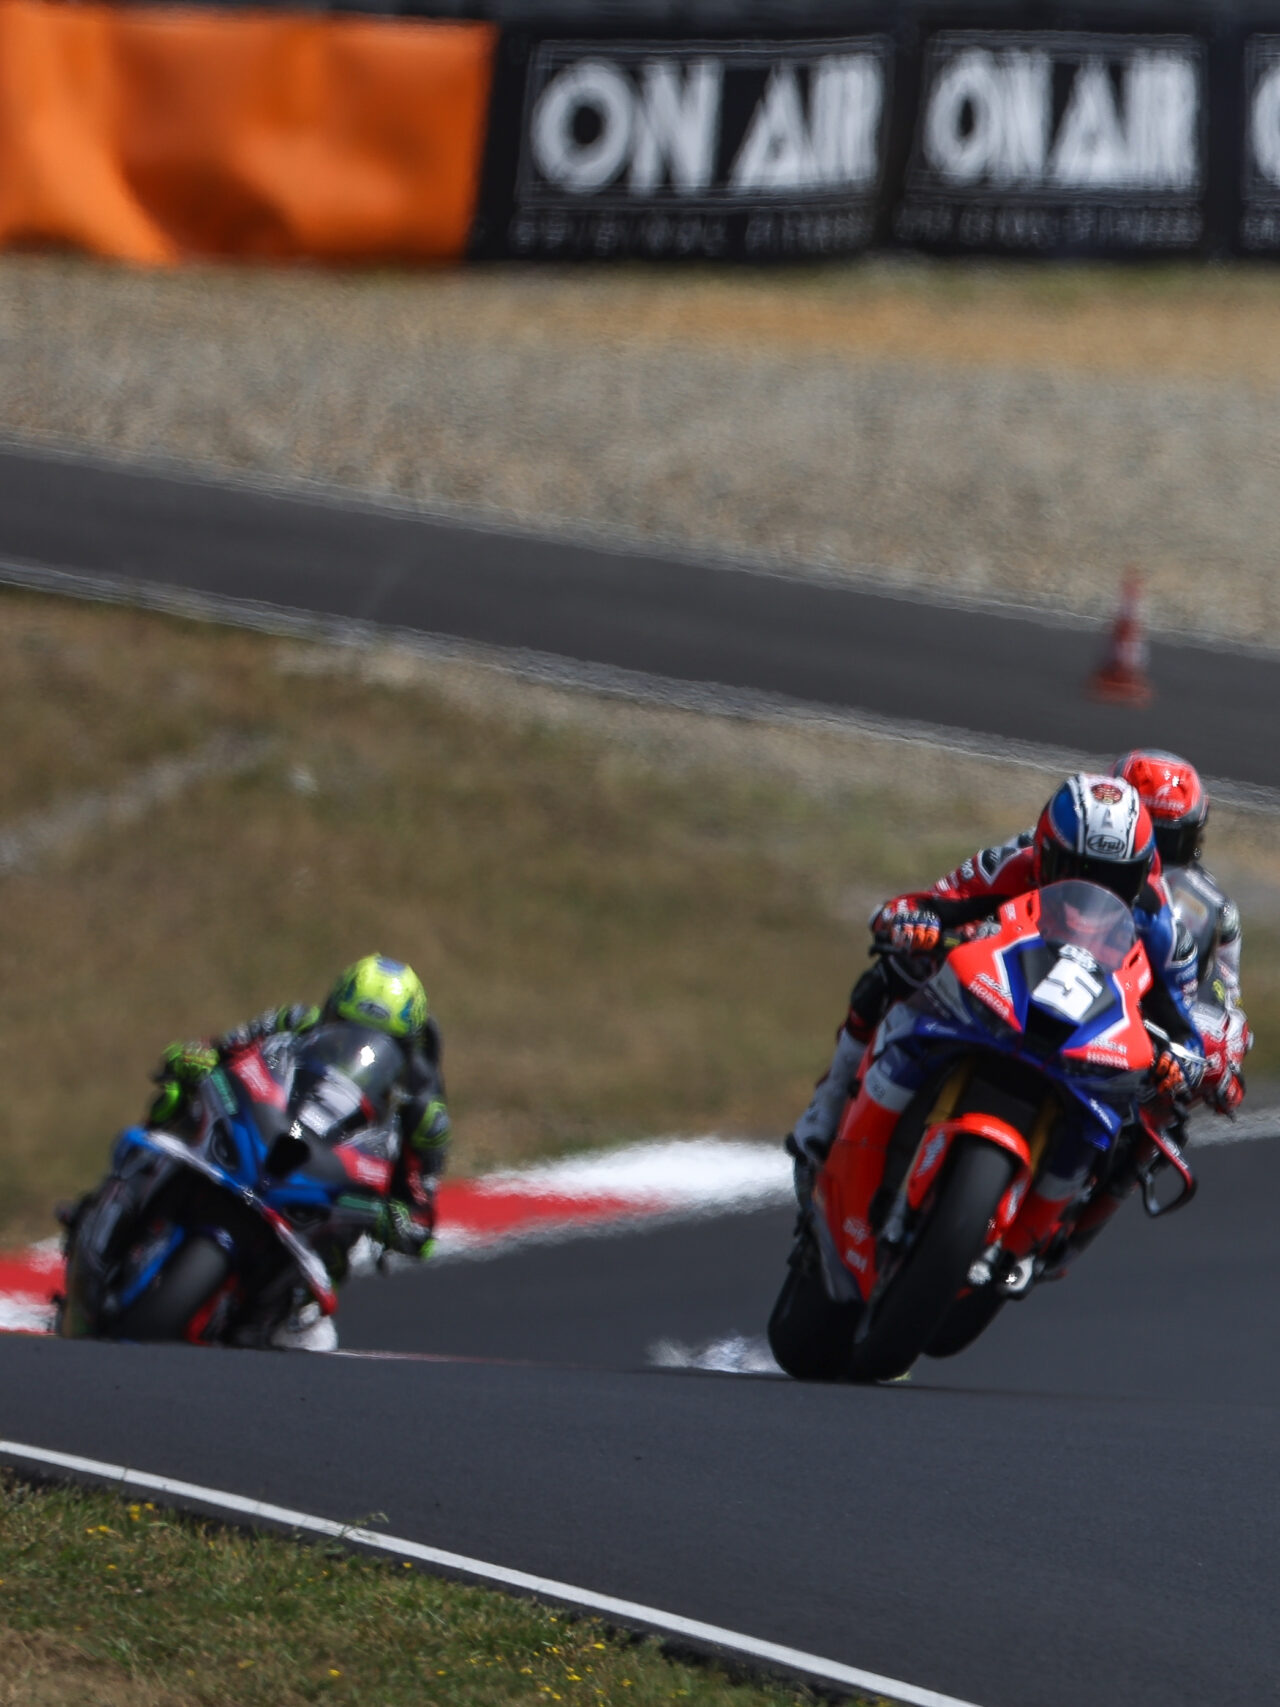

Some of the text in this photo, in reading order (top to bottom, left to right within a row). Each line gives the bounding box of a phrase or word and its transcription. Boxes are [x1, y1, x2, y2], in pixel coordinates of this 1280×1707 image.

[531, 50, 885, 196] ON AIR
[922, 47, 1198, 192] ON AIR
